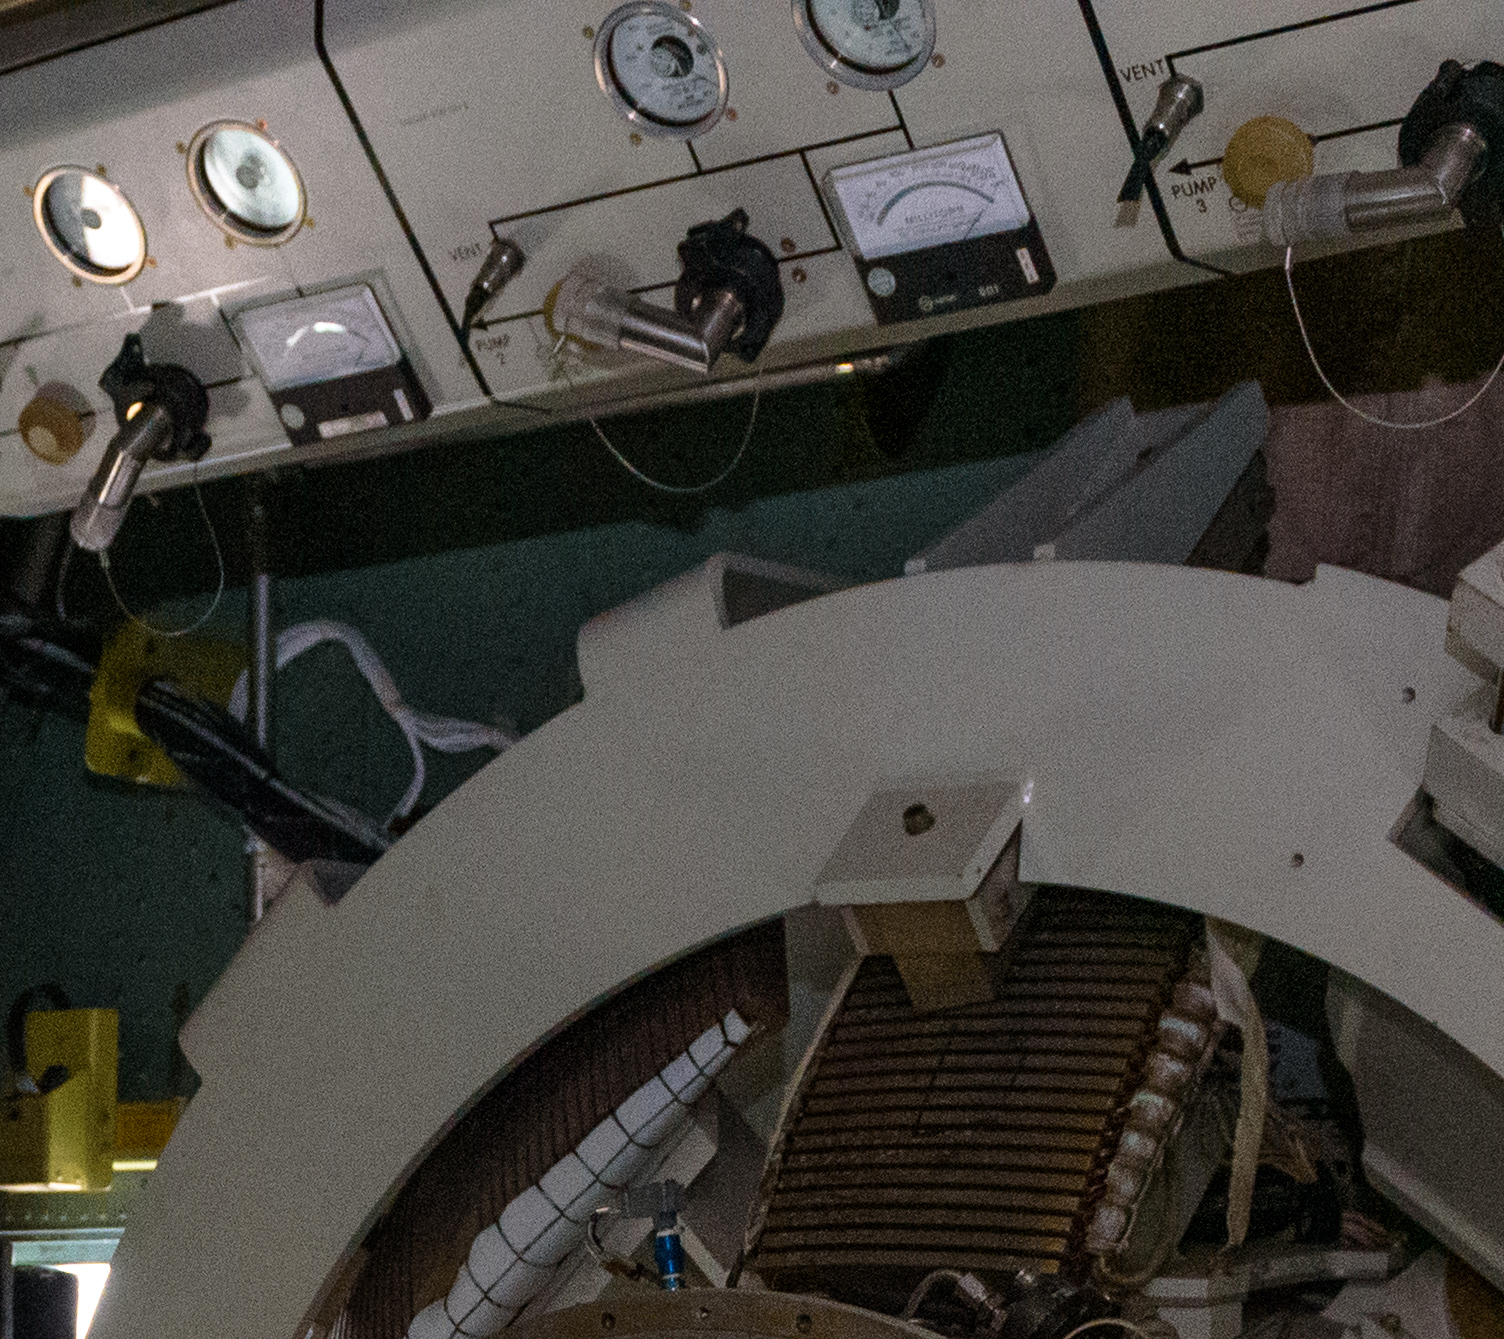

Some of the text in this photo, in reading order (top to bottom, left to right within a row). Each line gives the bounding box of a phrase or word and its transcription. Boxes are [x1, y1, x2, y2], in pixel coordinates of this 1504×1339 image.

[1120, 59, 1166, 84] VENT
[1171, 176, 1218, 200] PUMP
[1195, 198, 1209, 215] 3
[449, 242, 483, 262] VENT
[475, 333, 512, 353] PUMP
[495, 351, 506, 367] 2
